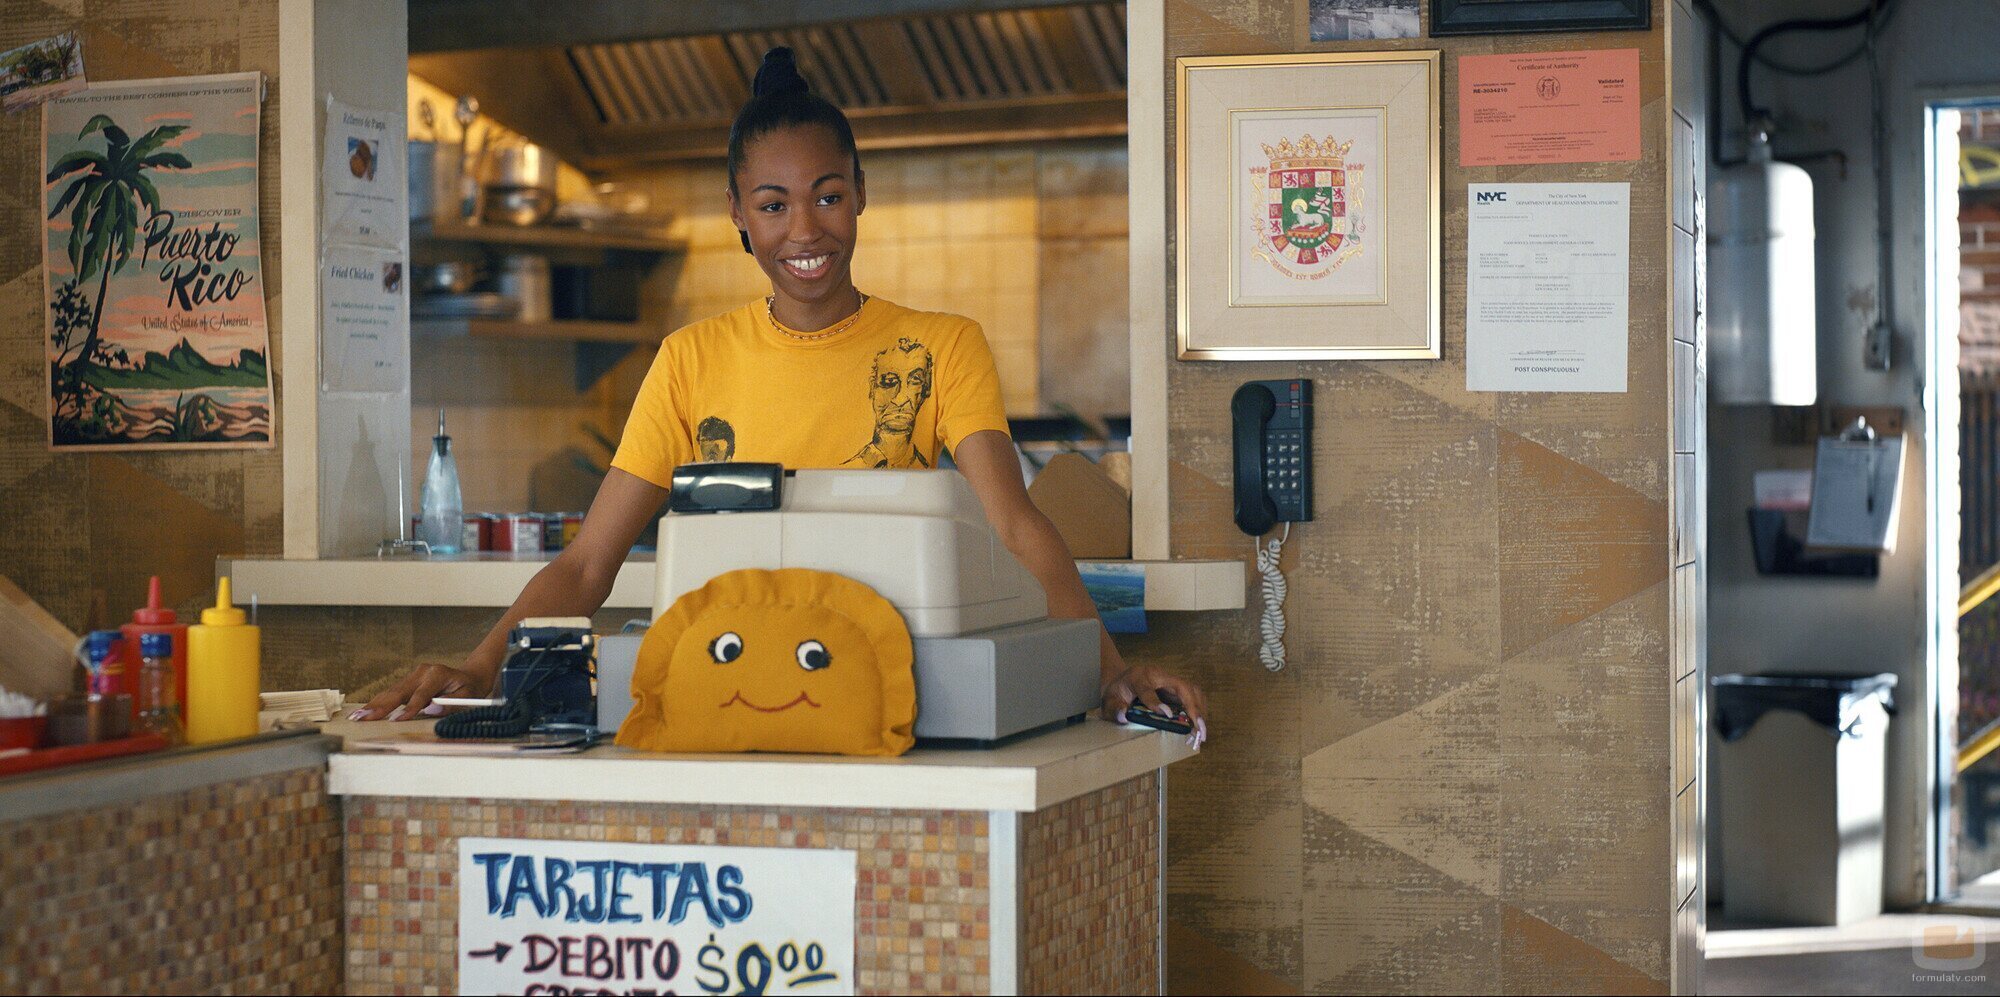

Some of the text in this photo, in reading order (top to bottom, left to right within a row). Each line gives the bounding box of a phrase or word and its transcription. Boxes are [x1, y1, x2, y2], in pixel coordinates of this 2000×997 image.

[148, 91, 188, 99] CORNERS
[222, 86, 253, 95] WORLD
[1477, 192, 1507, 202] NYC
[178, 208, 241, 218] DISCOVER
[141, 210, 241, 269] Puerto
[160, 256, 254, 311] Rico
[331, 265, 375, 281] Fried Chicken
[142, 312, 253, 333] United States of America
[473, 853, 753, 928] TARJETAS
[520, 934, 680, 980] DEBITO
